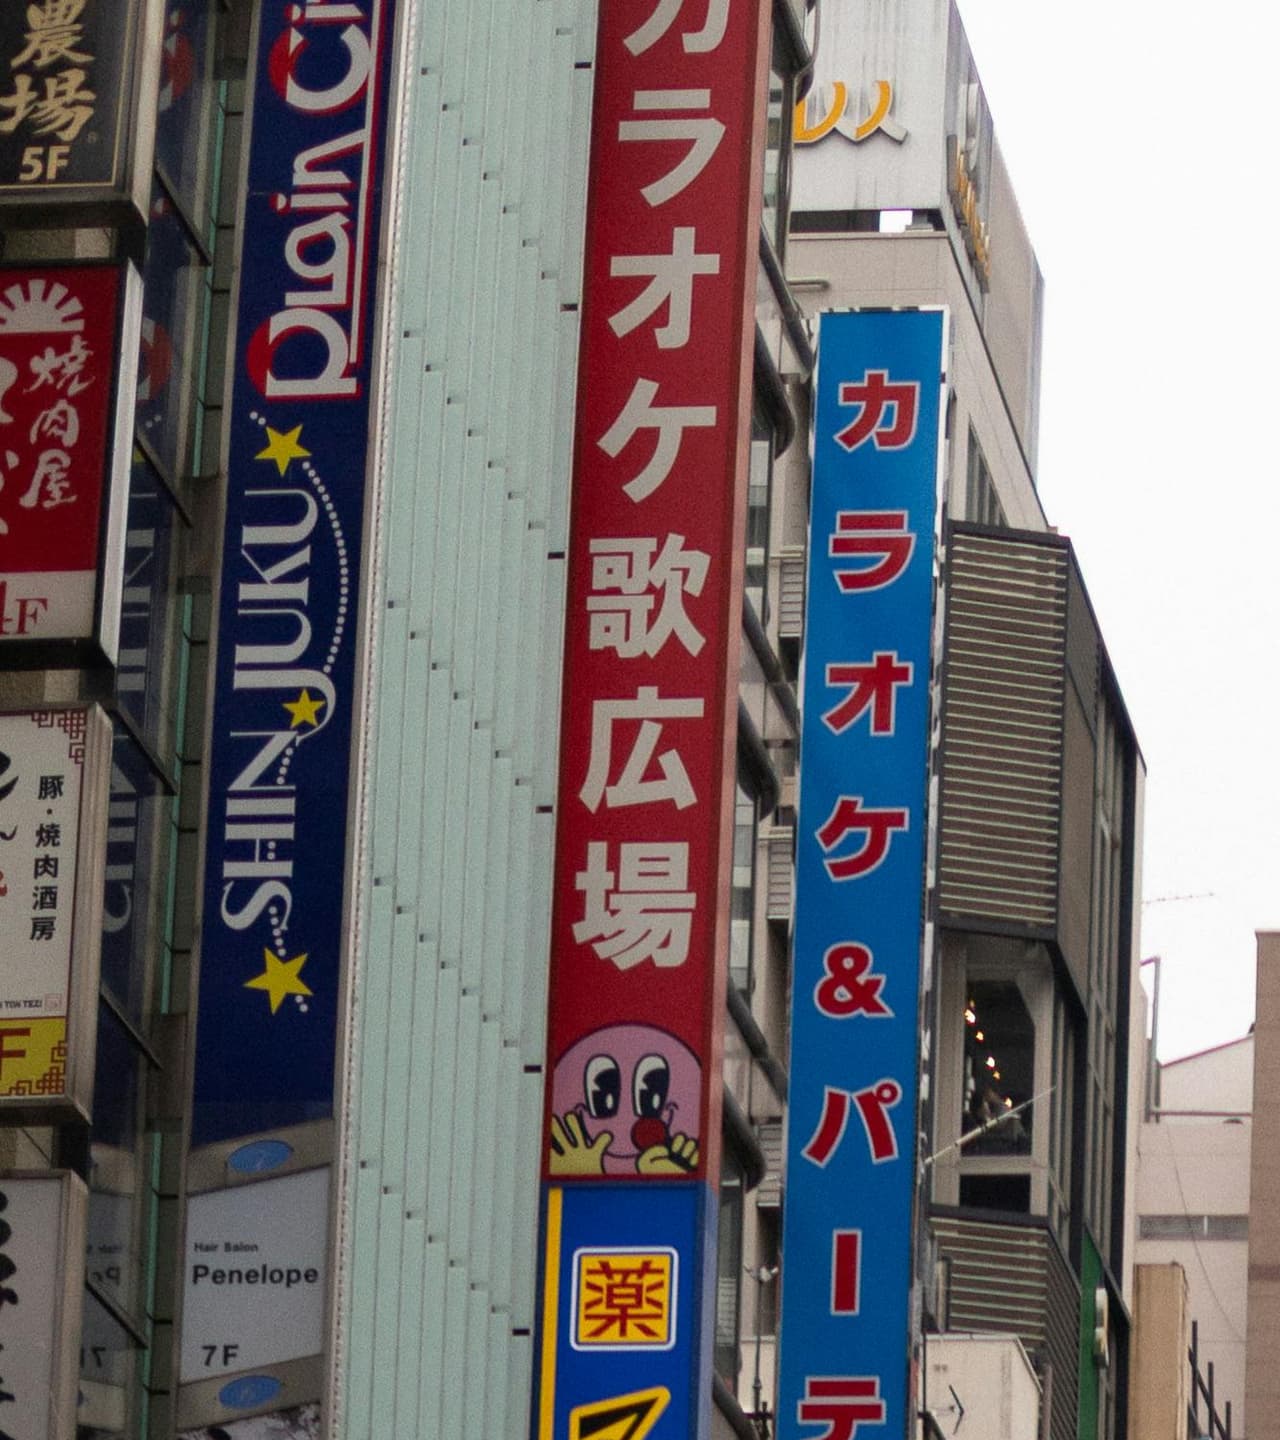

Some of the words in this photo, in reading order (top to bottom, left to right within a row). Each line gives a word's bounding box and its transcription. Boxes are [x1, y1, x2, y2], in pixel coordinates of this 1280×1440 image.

[20, 145, 72, 183] 5F
[21, 334, 95, 508] 焼肉屋
[220, 487, 337, 932] SHINJUKU
[29, 774, 64, 941] 豚・焼肉酒房
[193, 1264, 319, 1289] Penelope
[194, 1242, 221, 1253] Hair
[225, 1242, 259, 1253] Salon
[583, 1259, 666, 1338] 薬
[203, 1345, 239, 1366] 7F
